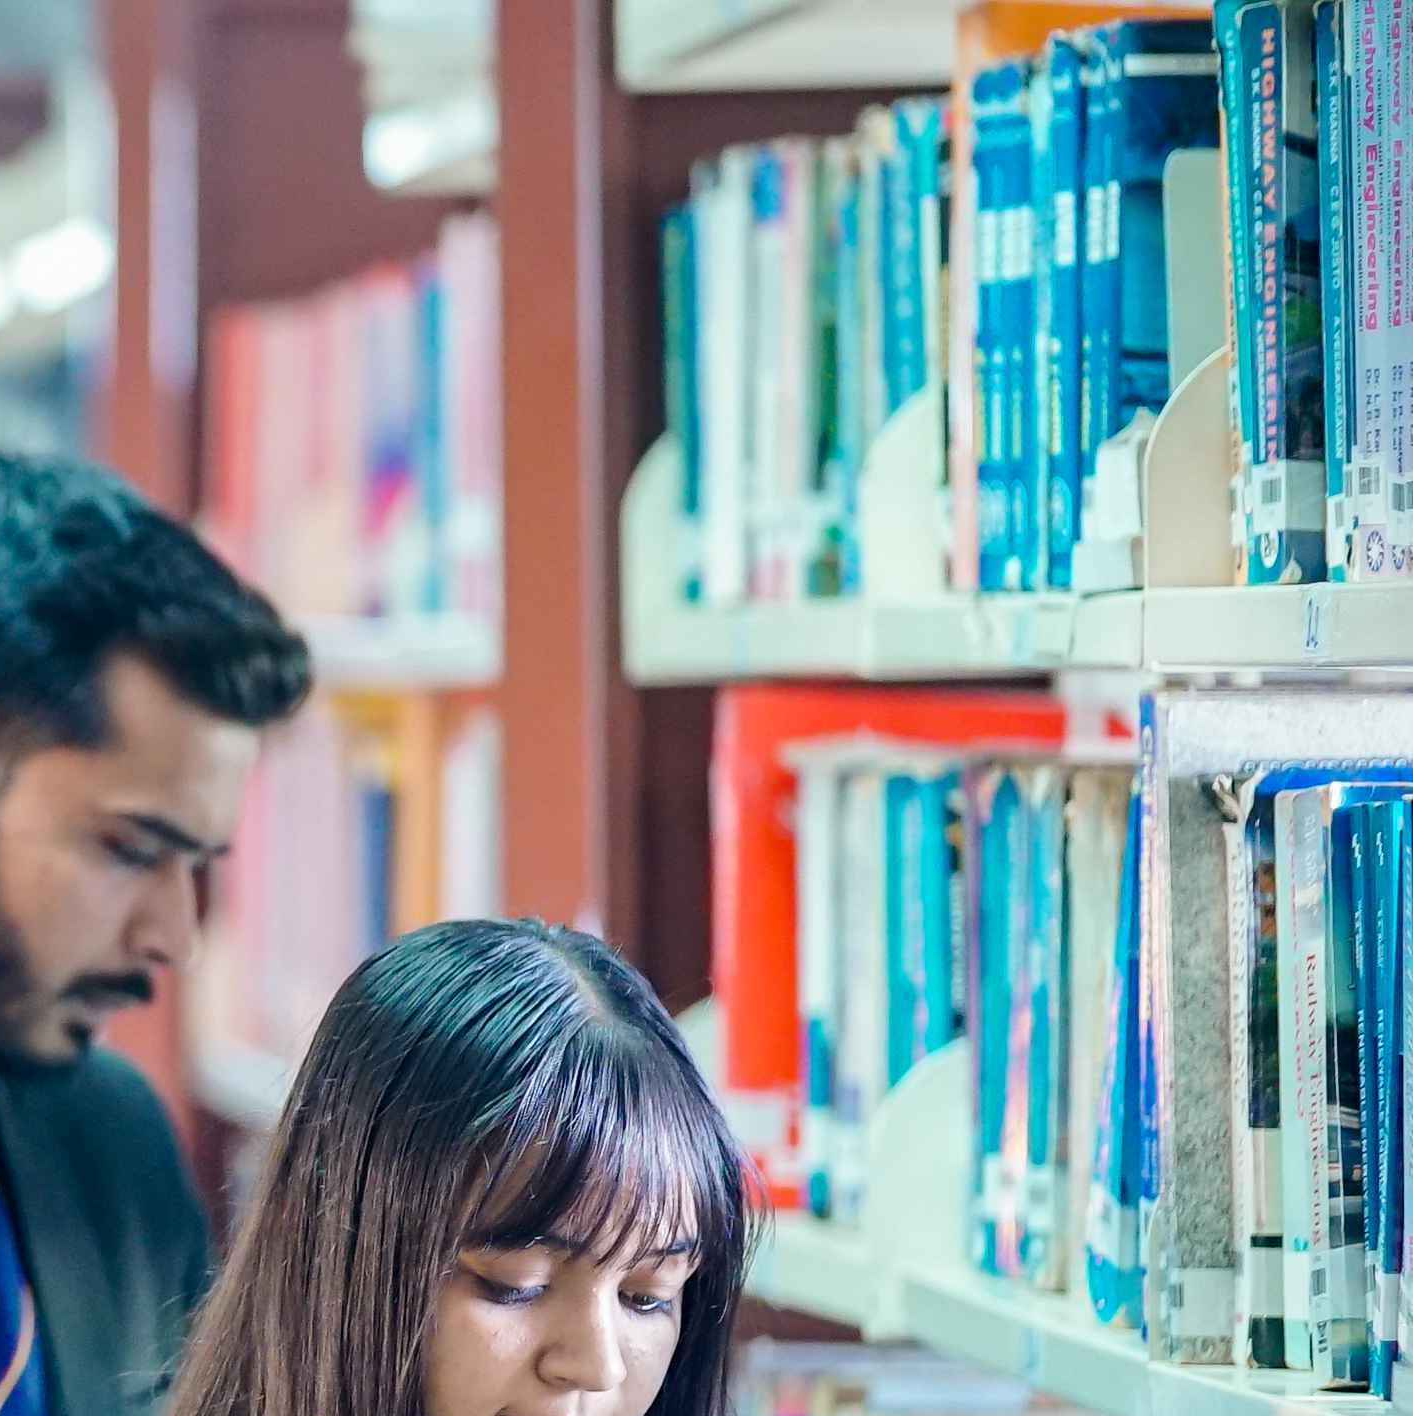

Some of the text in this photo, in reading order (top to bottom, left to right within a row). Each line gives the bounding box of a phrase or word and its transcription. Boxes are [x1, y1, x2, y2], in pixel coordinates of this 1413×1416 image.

[1252, 102, 1261, 171] KHANNA
[1329, 96, 1340, 165] KHANNA
[1261, 28, 1278, 465] HIGHWAY ENGINEERIN
[1363, 144, 1381, 330] Engineering
[1392, 141, 1403, 327] Engineering
[1306, 953, 1321, 1246] Railway Engineering
[1357, 1009, 1367, 1123] RENEWABLE
[1377, 1008, 1386, 1123] RENEWABLE
[1360, 1129, 1369, 1199] ENERGY
